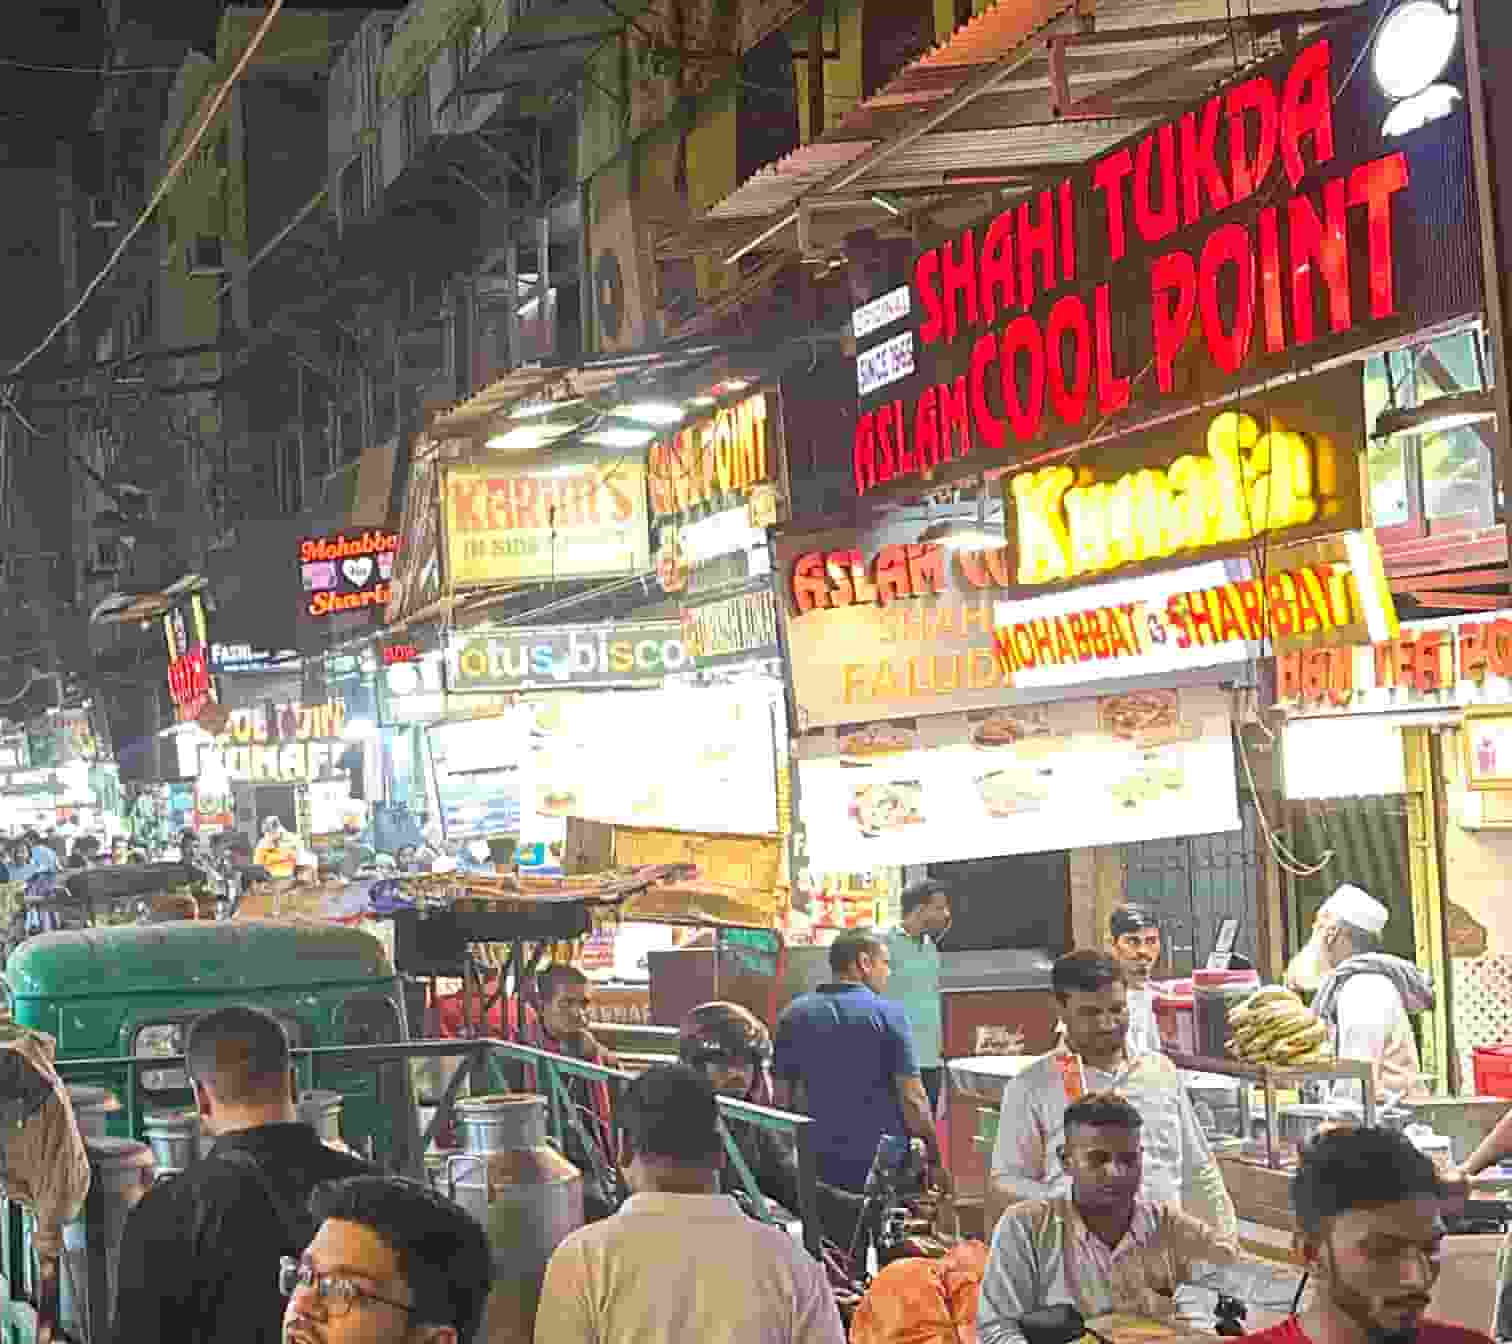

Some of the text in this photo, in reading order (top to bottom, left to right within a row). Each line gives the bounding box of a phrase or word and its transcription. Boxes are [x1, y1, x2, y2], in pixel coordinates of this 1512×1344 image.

[852, 376, 970, 496] ASLAM
[968, 283, 1131, 448] COOL
[1150, 151, 1410, 393] POINT
[913, 39, 1336, 346] SHAHI TUKDA
[992, 601, 1145, 683] MOHABBAT
